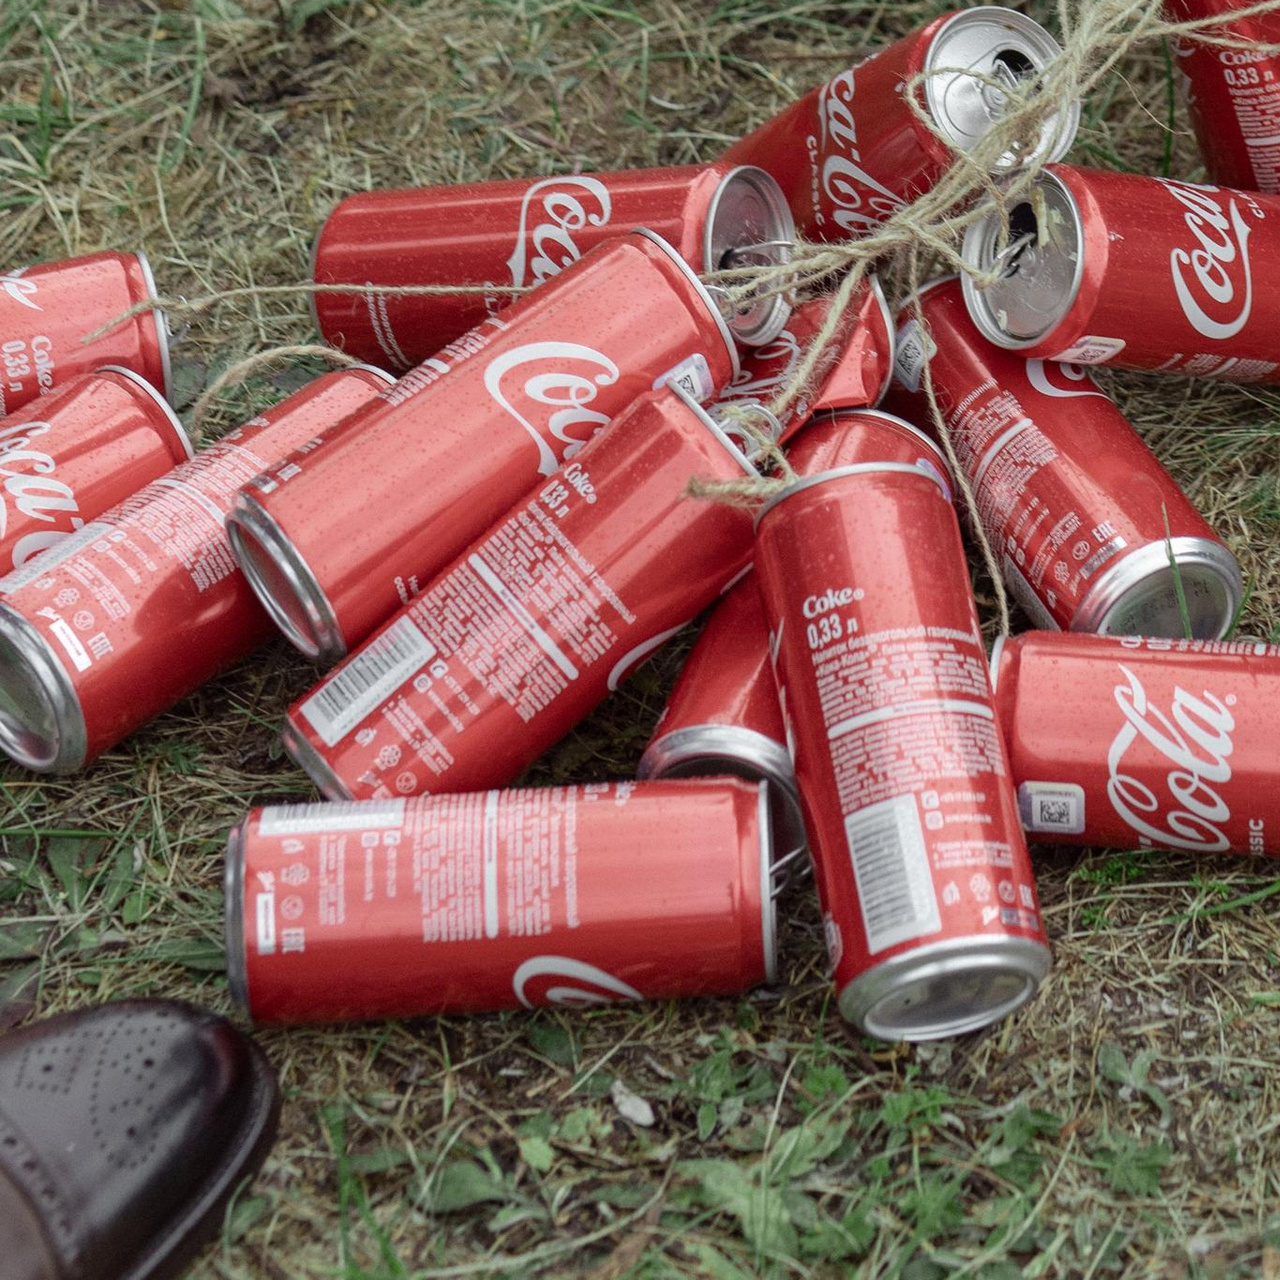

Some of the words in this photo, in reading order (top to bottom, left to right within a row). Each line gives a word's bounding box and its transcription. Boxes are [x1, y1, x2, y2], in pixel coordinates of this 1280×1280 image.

[1223, 67, 1260, 89] 0,33
[806, 135, 827, 227] CLASSIC
[2, 339, 31, 379] 0,33
[31, 335, 55, 390] Coke
[563, 462, 595, 498] Coke
[803, 587, 853, 619] Coke
[806, 613, 843, 650] 0,33
[1249, 818, 1265, 856] SSIC
